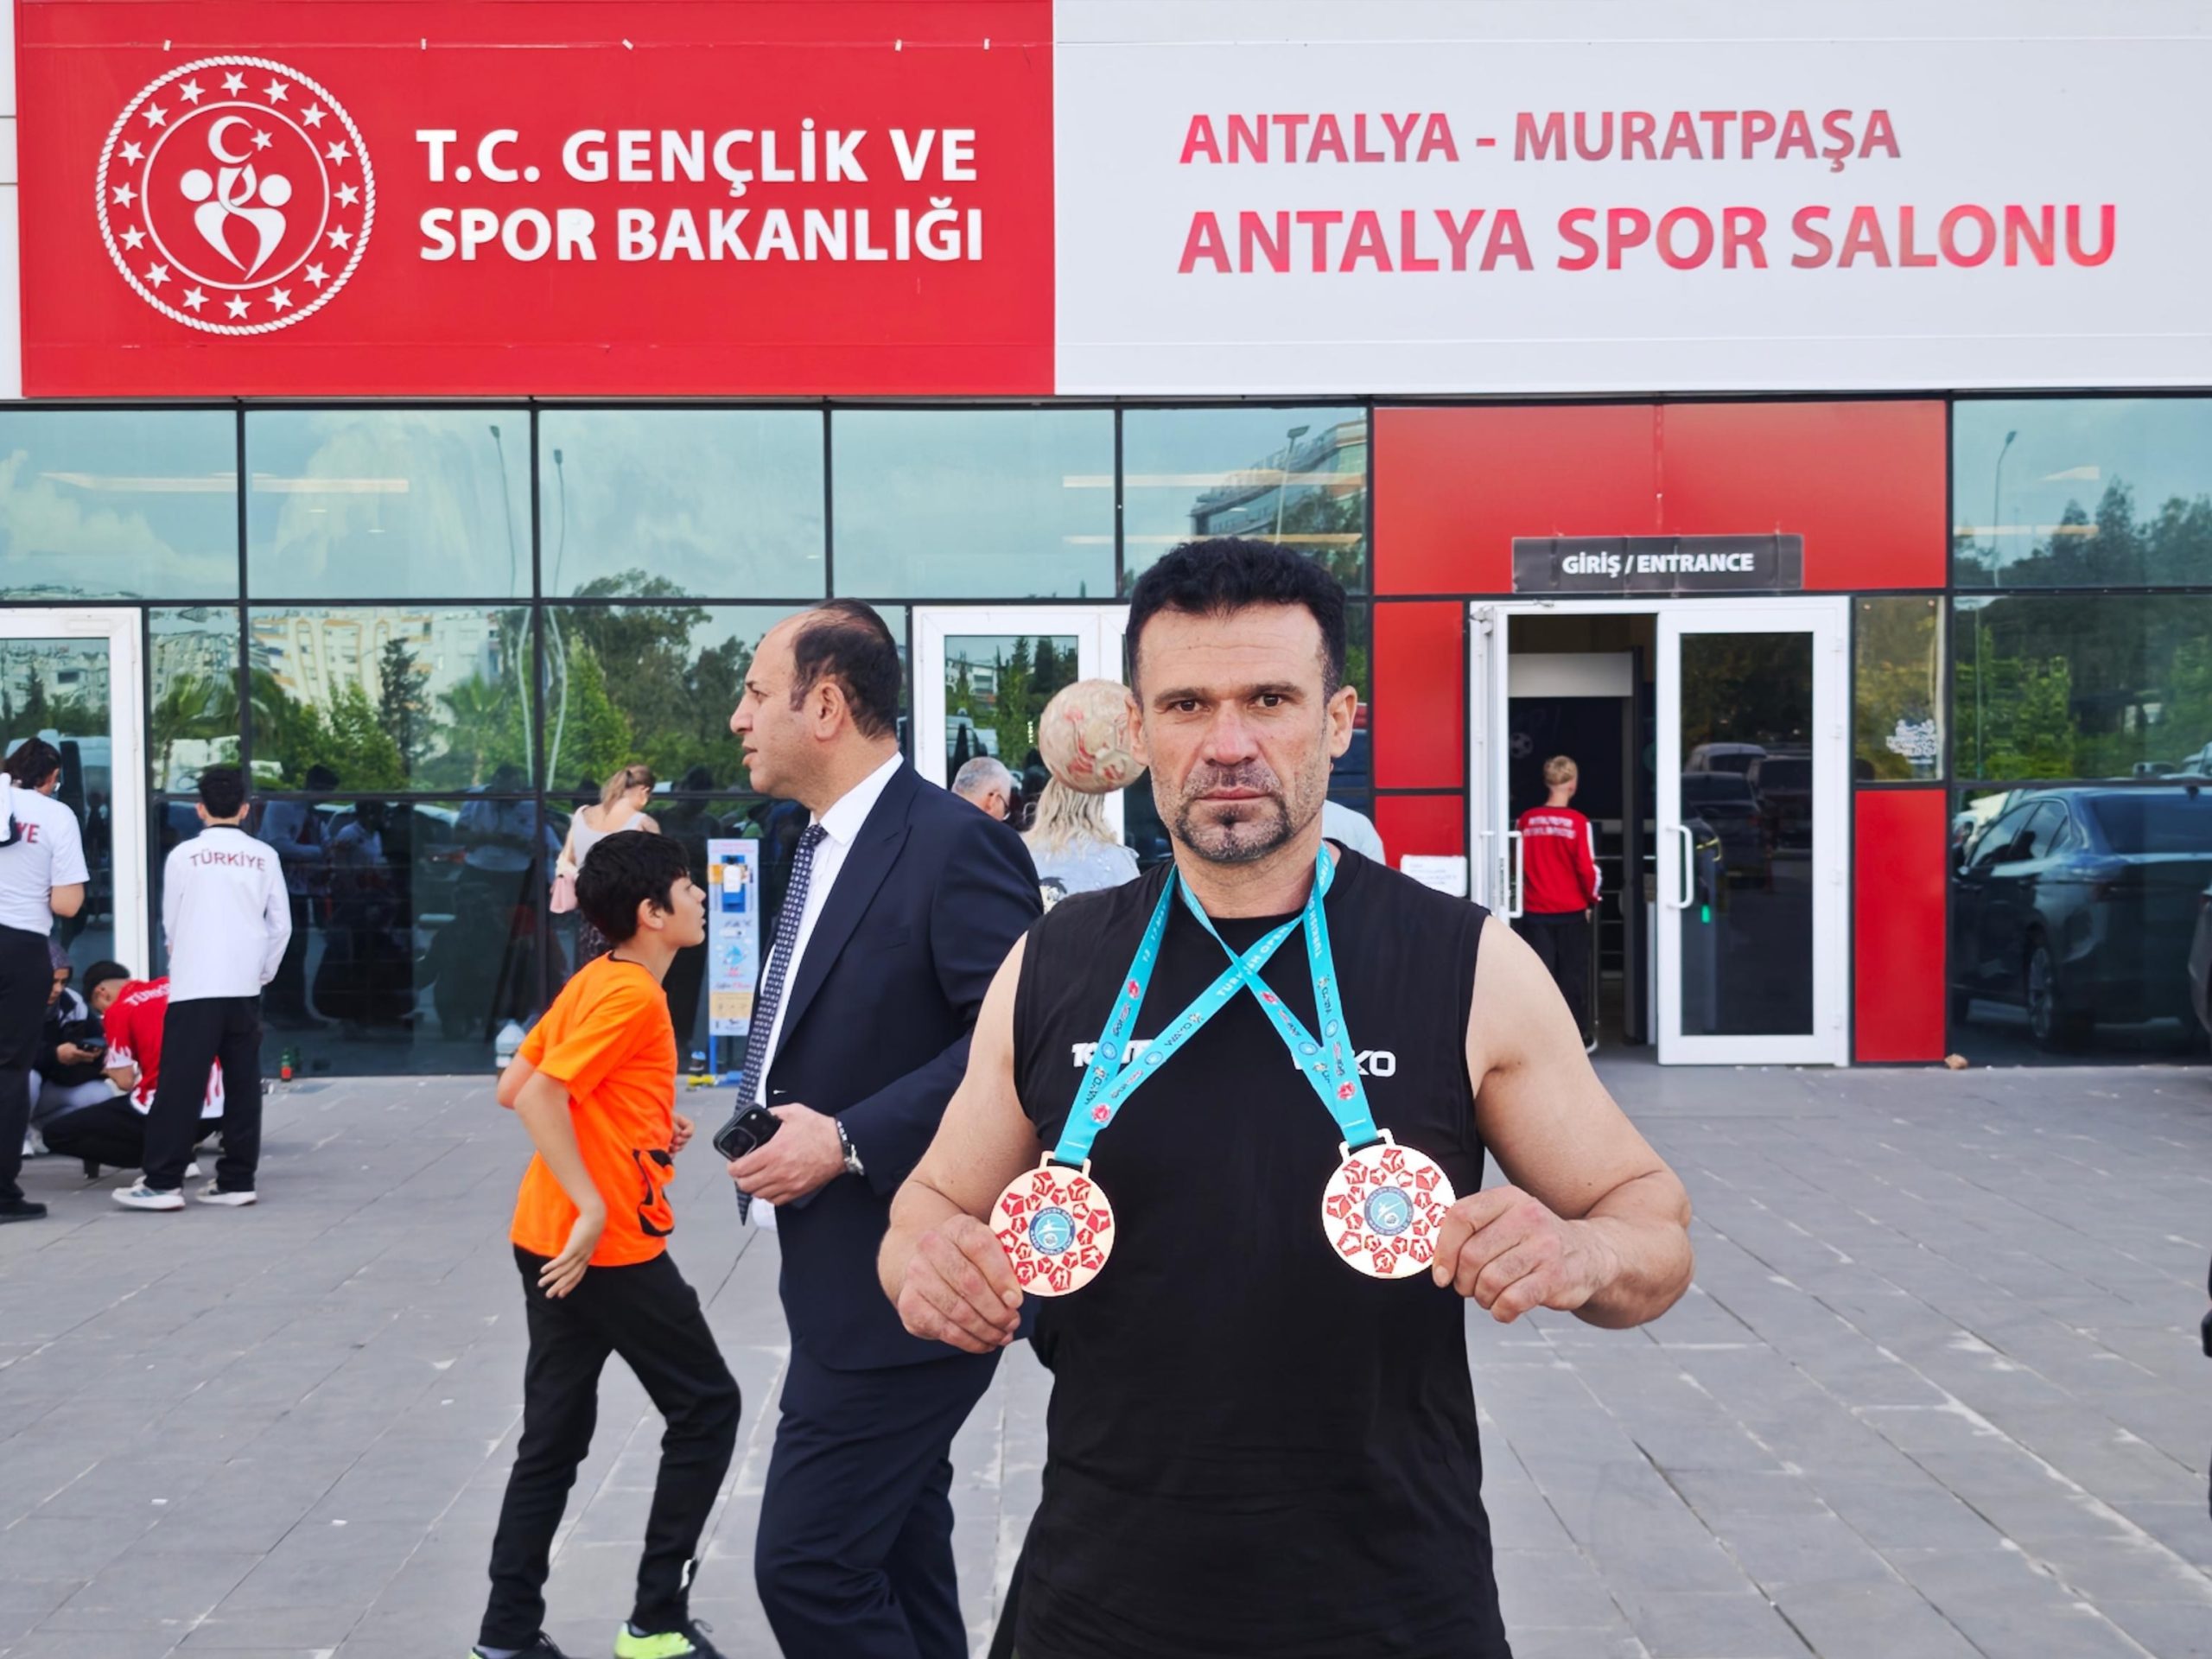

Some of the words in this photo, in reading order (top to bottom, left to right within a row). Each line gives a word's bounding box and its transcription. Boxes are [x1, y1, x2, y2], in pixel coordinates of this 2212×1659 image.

[416, 130, 540, 182] T.C.
[563, 118, 868, 197] GENÇLİK
[889, 129, 977, 181] VE
[1179, 112, 1459, 164] ANTALYA
[1477, 138, 1496, 147] -
[1515, 109, 1901, 175] MURATPAŞA
[419, 207, 597, 262] SPOR
[618, 197, 982, 261] BAKANLIĞI
[1178, 208, 1535, 274] ANTALYA
[1556, 207, 1769, 272] SPOR
[1790, 203, 2116, 270] SALONU
[1561, 551, 1621, 579] GİRİŞ
[1637, 553, 1755, 574] ENTRANCE
[190, 849, 265, 872] TÜRKİYE
[1215, 955, 1262, 996] TURKSH
